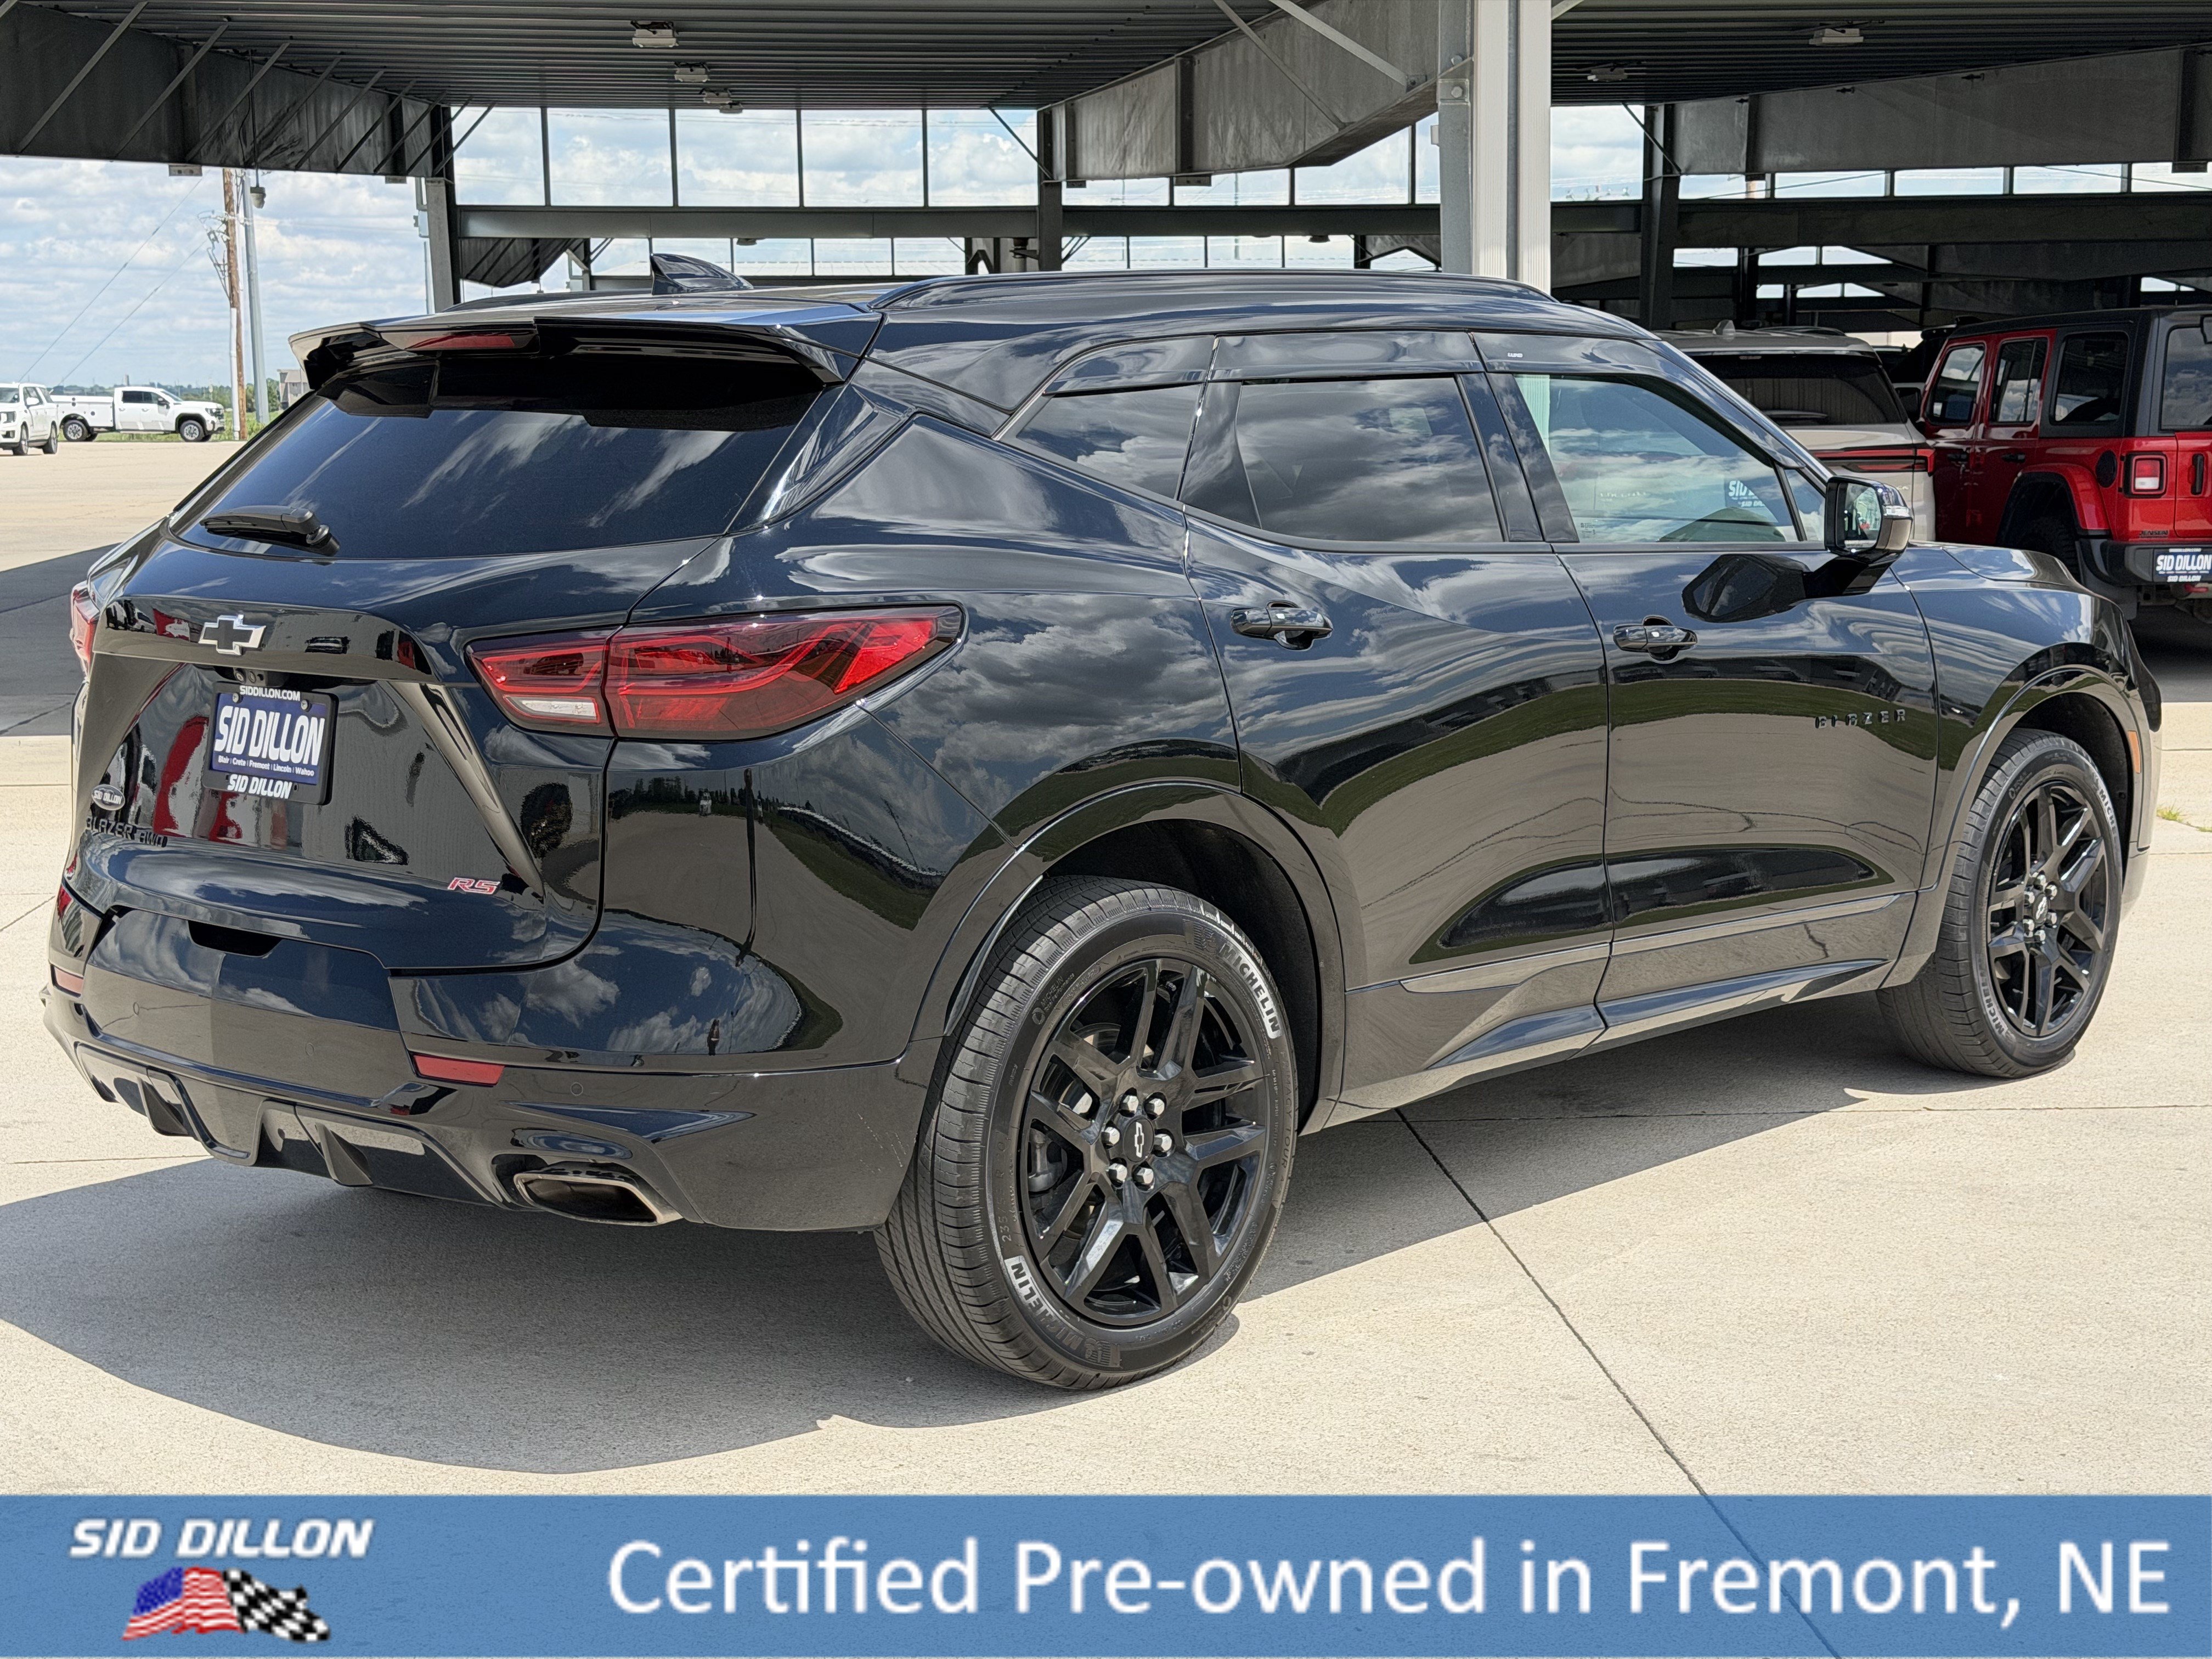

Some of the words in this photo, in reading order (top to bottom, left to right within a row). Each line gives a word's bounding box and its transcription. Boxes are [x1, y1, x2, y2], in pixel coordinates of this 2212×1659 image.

[2155, 555, 2175, 571] SID
[2175, 554, 2212, 571] DILLON
[240, 685, 301, 702] SIDDILLON.COM
[1814, 708, 1906, 729] BLAZER
[213, 706, 250, 755] SID
[248, 709, 325, 766] DILLON
[218, 755, 230, 764] Blair
[232, 758, 247, 767] Crete
[249, 760, 270, 770] Fremont
[273, 763, 292, 774] Lincoln
[295, 766, 315, 777] Wahoo
[93, 789, 103, 800] SID
[103, 792, 122, 805] DILLON
[227, 774, 249, 793] SID
[248, 776, 293, 799] DILLON
[86, 816, 135, 840] BLAZER
[447, 877, 501, 895] RS
[1218, 942, 1280, 1033] MICHELIN
[1011, 1262, 1084, 1350] MICHELIN
